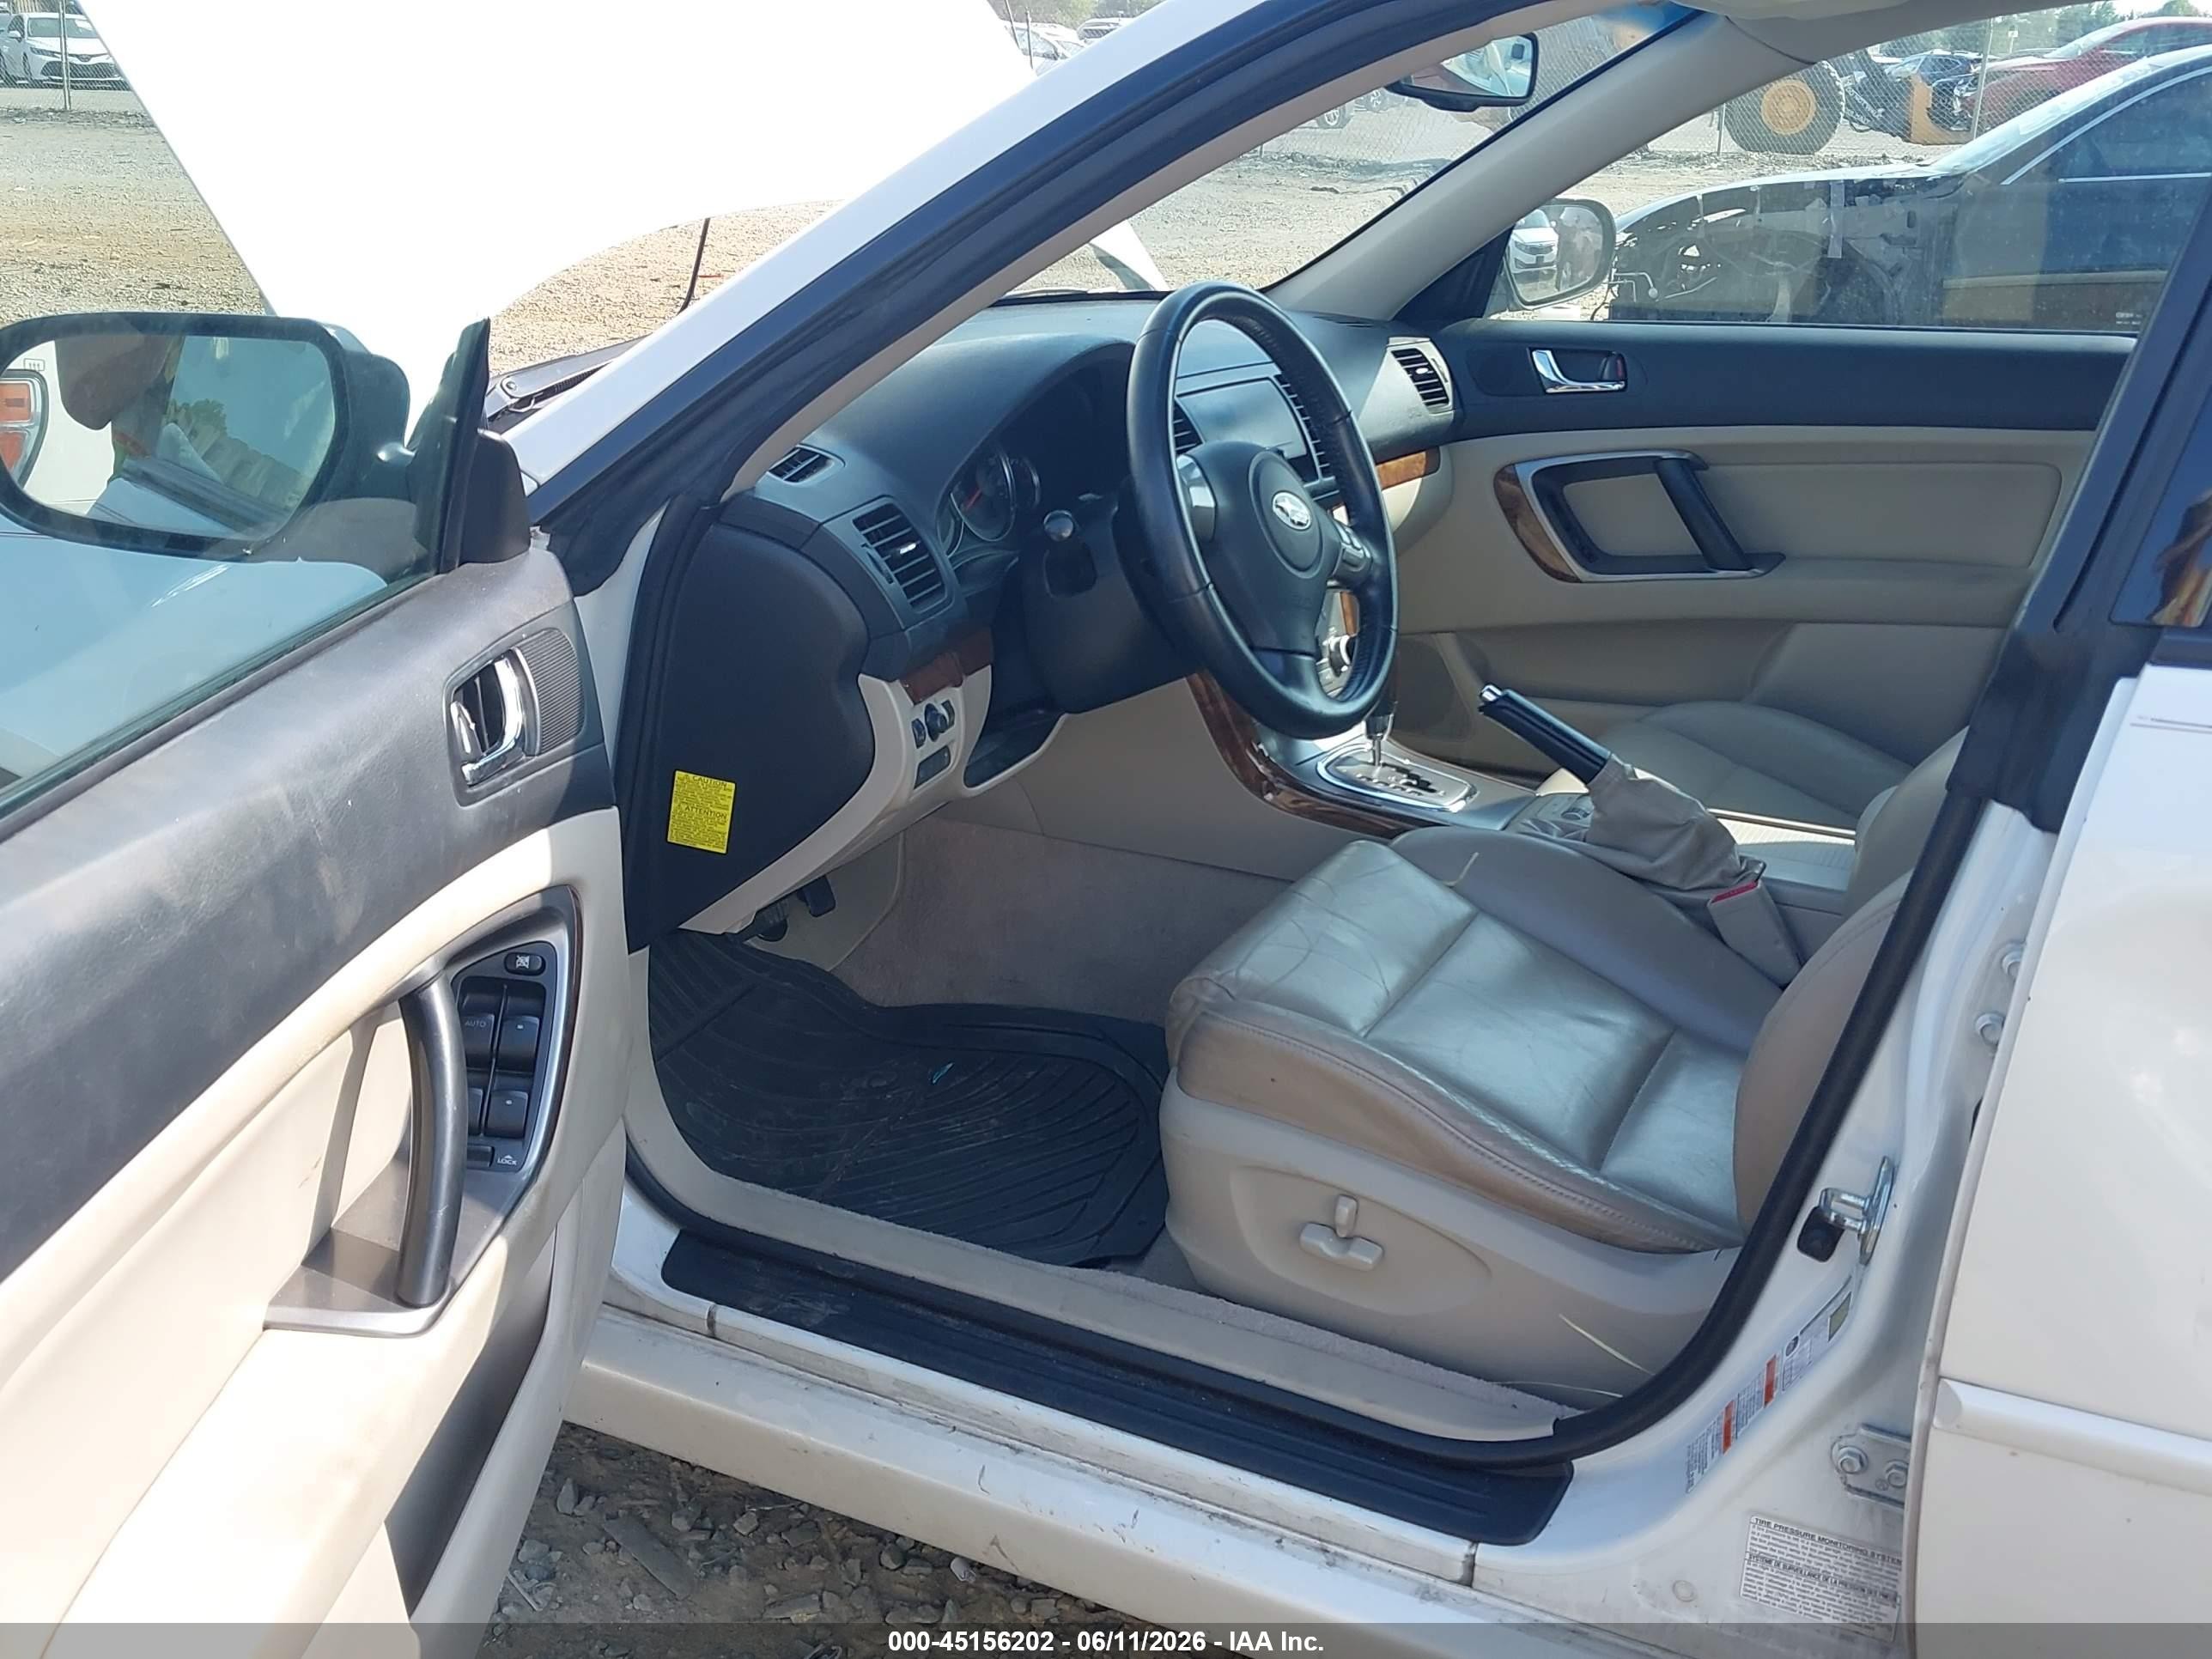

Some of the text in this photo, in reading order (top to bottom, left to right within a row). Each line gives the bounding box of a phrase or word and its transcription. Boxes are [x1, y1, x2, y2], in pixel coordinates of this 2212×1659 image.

[693, 775, 727, 787] CAUTION
[685, 806, 727, 819] ATTENTION
[1754, 1517, 1771, 1527] TIRE
[1773, 1523, 1816, 1540] PRESSURE
[1818, 1535, 1869, 1556] MONITORING
